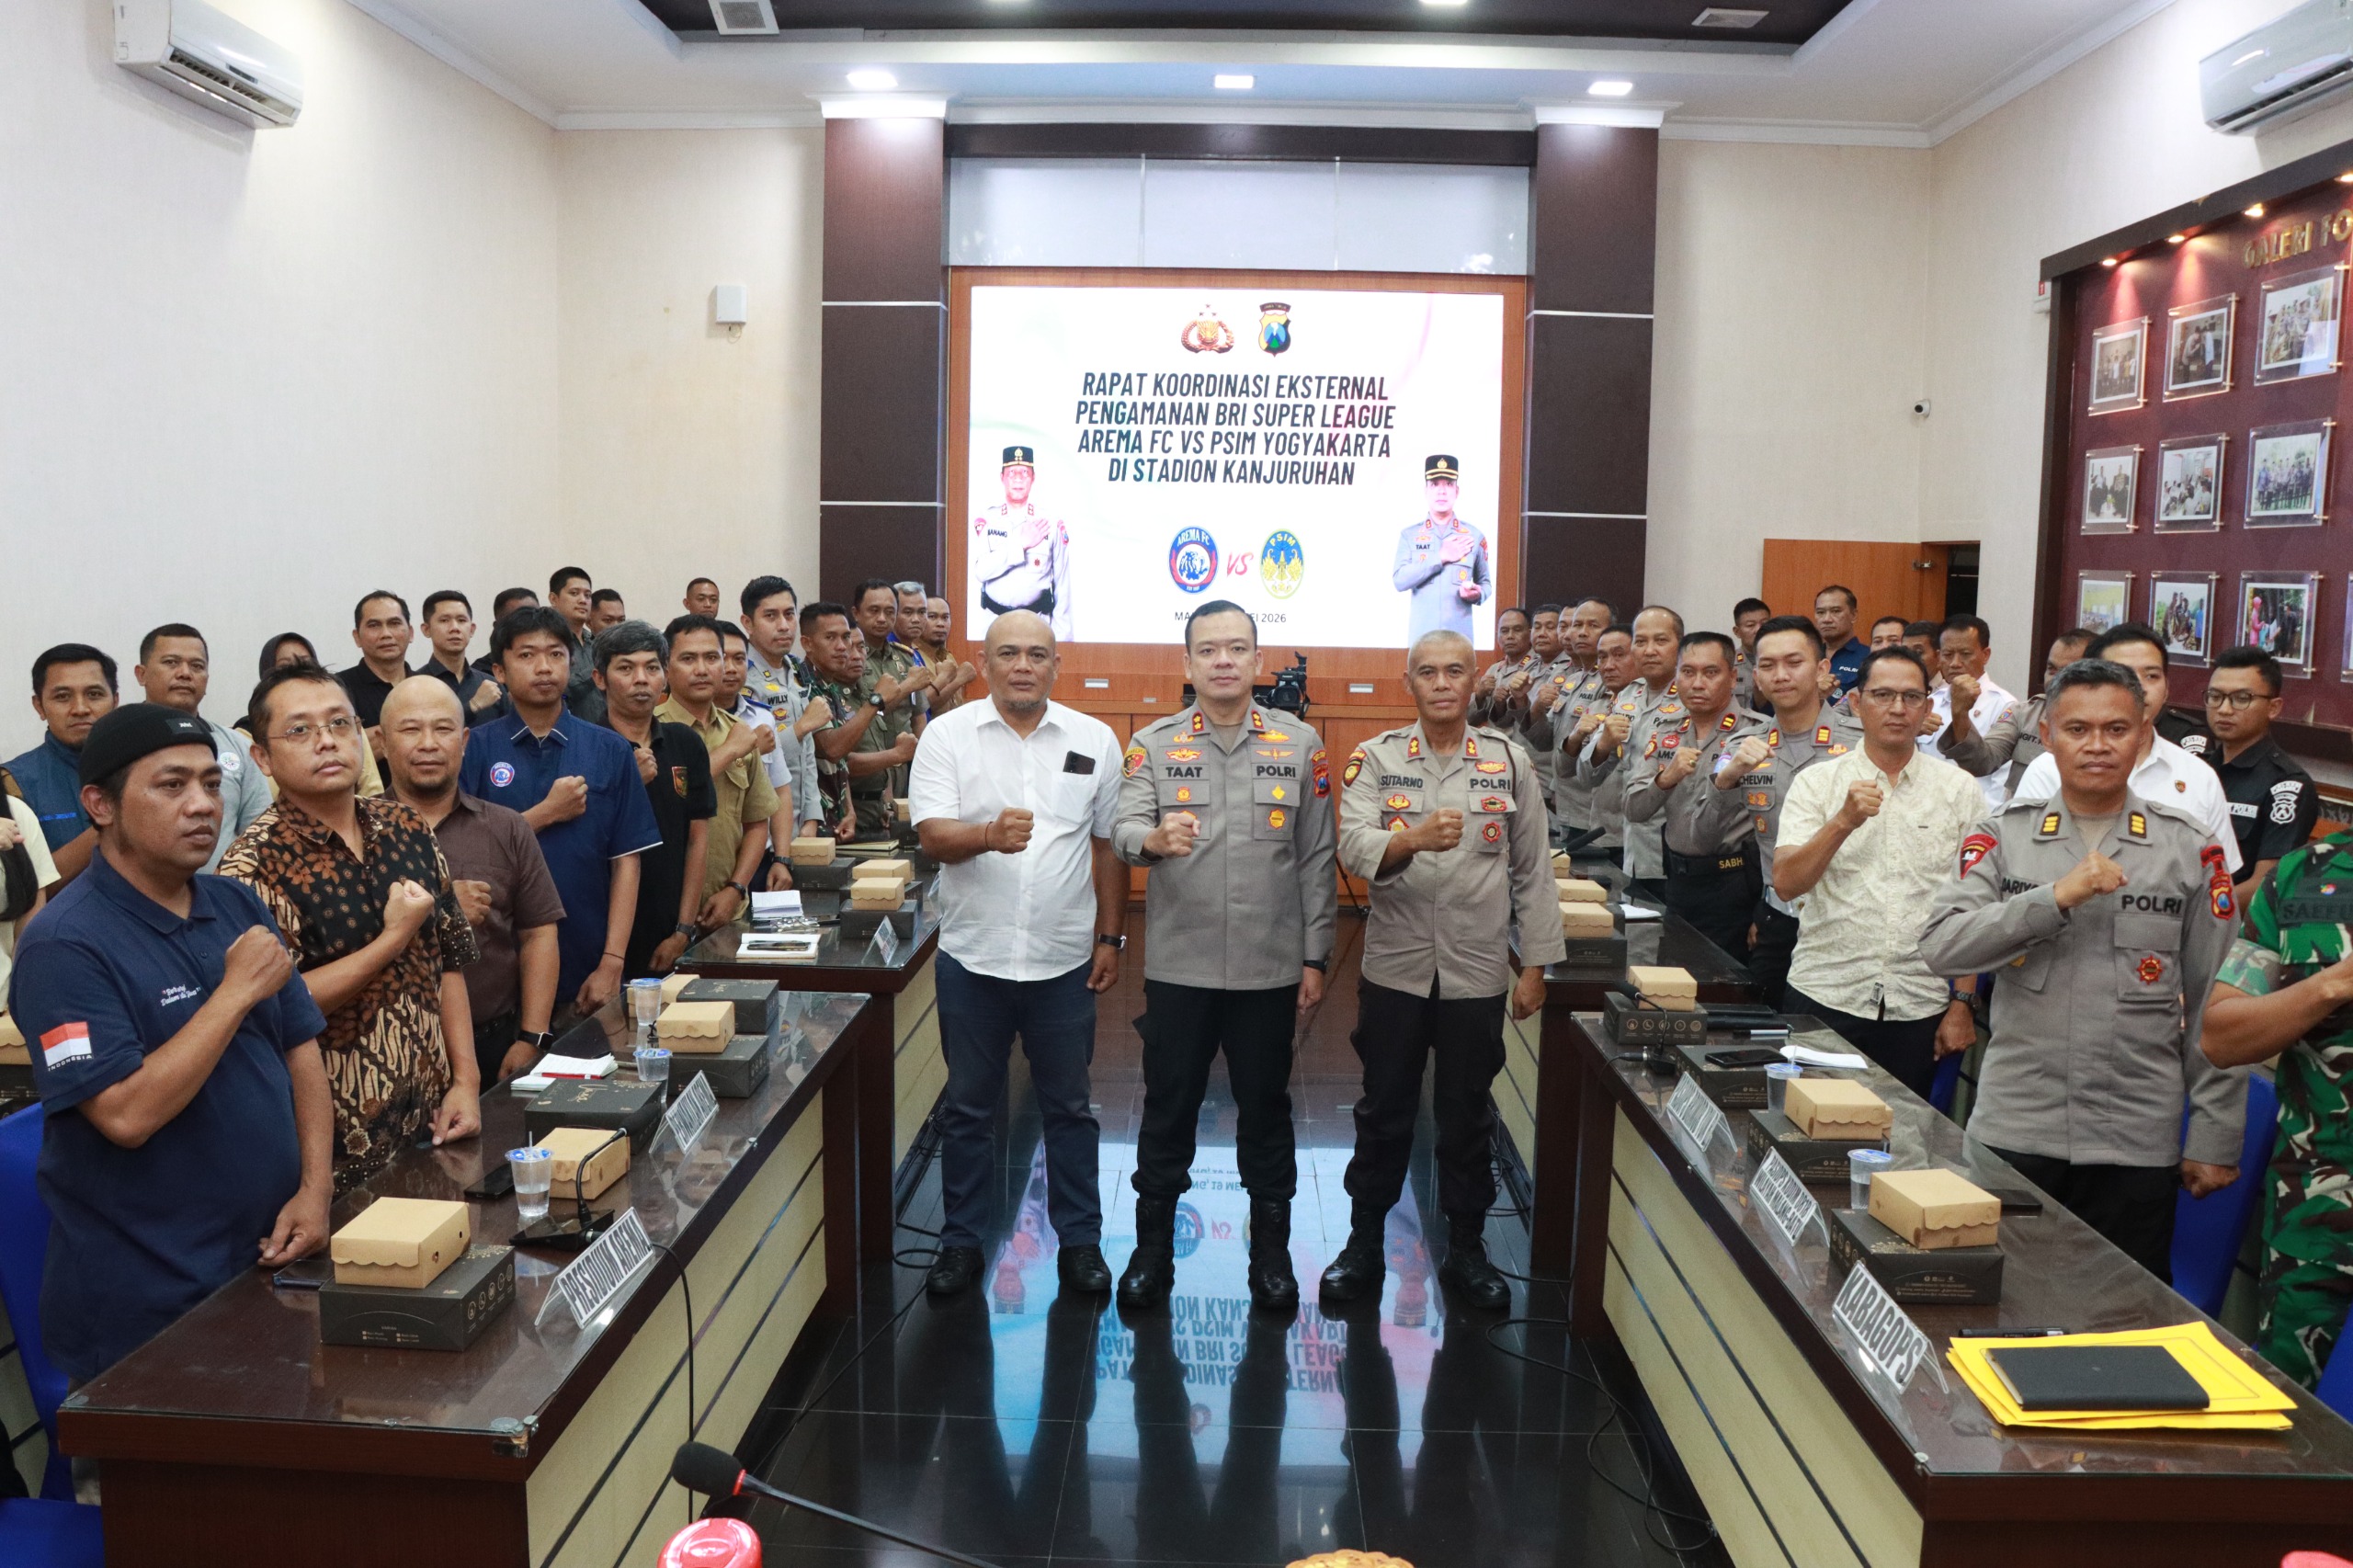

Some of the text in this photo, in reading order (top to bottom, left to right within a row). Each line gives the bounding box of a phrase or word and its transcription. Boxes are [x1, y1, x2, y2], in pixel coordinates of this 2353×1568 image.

[2244, 221, 2313, 268] GALERI
[1083, 372, 1389, 400] RAPAT KOORDINASI EKSTERNAL
[1075, 401, 1396, 429] PENGAMANAN BRI SUPER LEAGUE
[1078, 429, 1391, 458] AREMA FC VS PSIM YOGYAKARTA
[1108, 458, 1355, 485] DI STADION KANJURUHAN
[1176, 528, 1210, 547] AREMA FC
[1269, 533, 1296, 547] PSIM
[1227, 551, 1254, 577] VS
[1261, 613, 1287, 622] 2026
[767, 694, 788, 705] WILLY
[1165, 767, 1202, 778] TAAT
[1256, 765, 1296, 778] POLRI
[1381, 774, 1423, 789] SUTARNO
[1470, 778, 1511, 790] POLRI
[1719, 857, 1744, 869] SABH
[2121, 894, 2183, 914] POLRI
[48, 1054, 93, 1072] INDONESIA
[560, 1213, 651, 1321] PRESIDIUM AREMA
[1836, 1267, 1923, 1383] KABAGOPS
